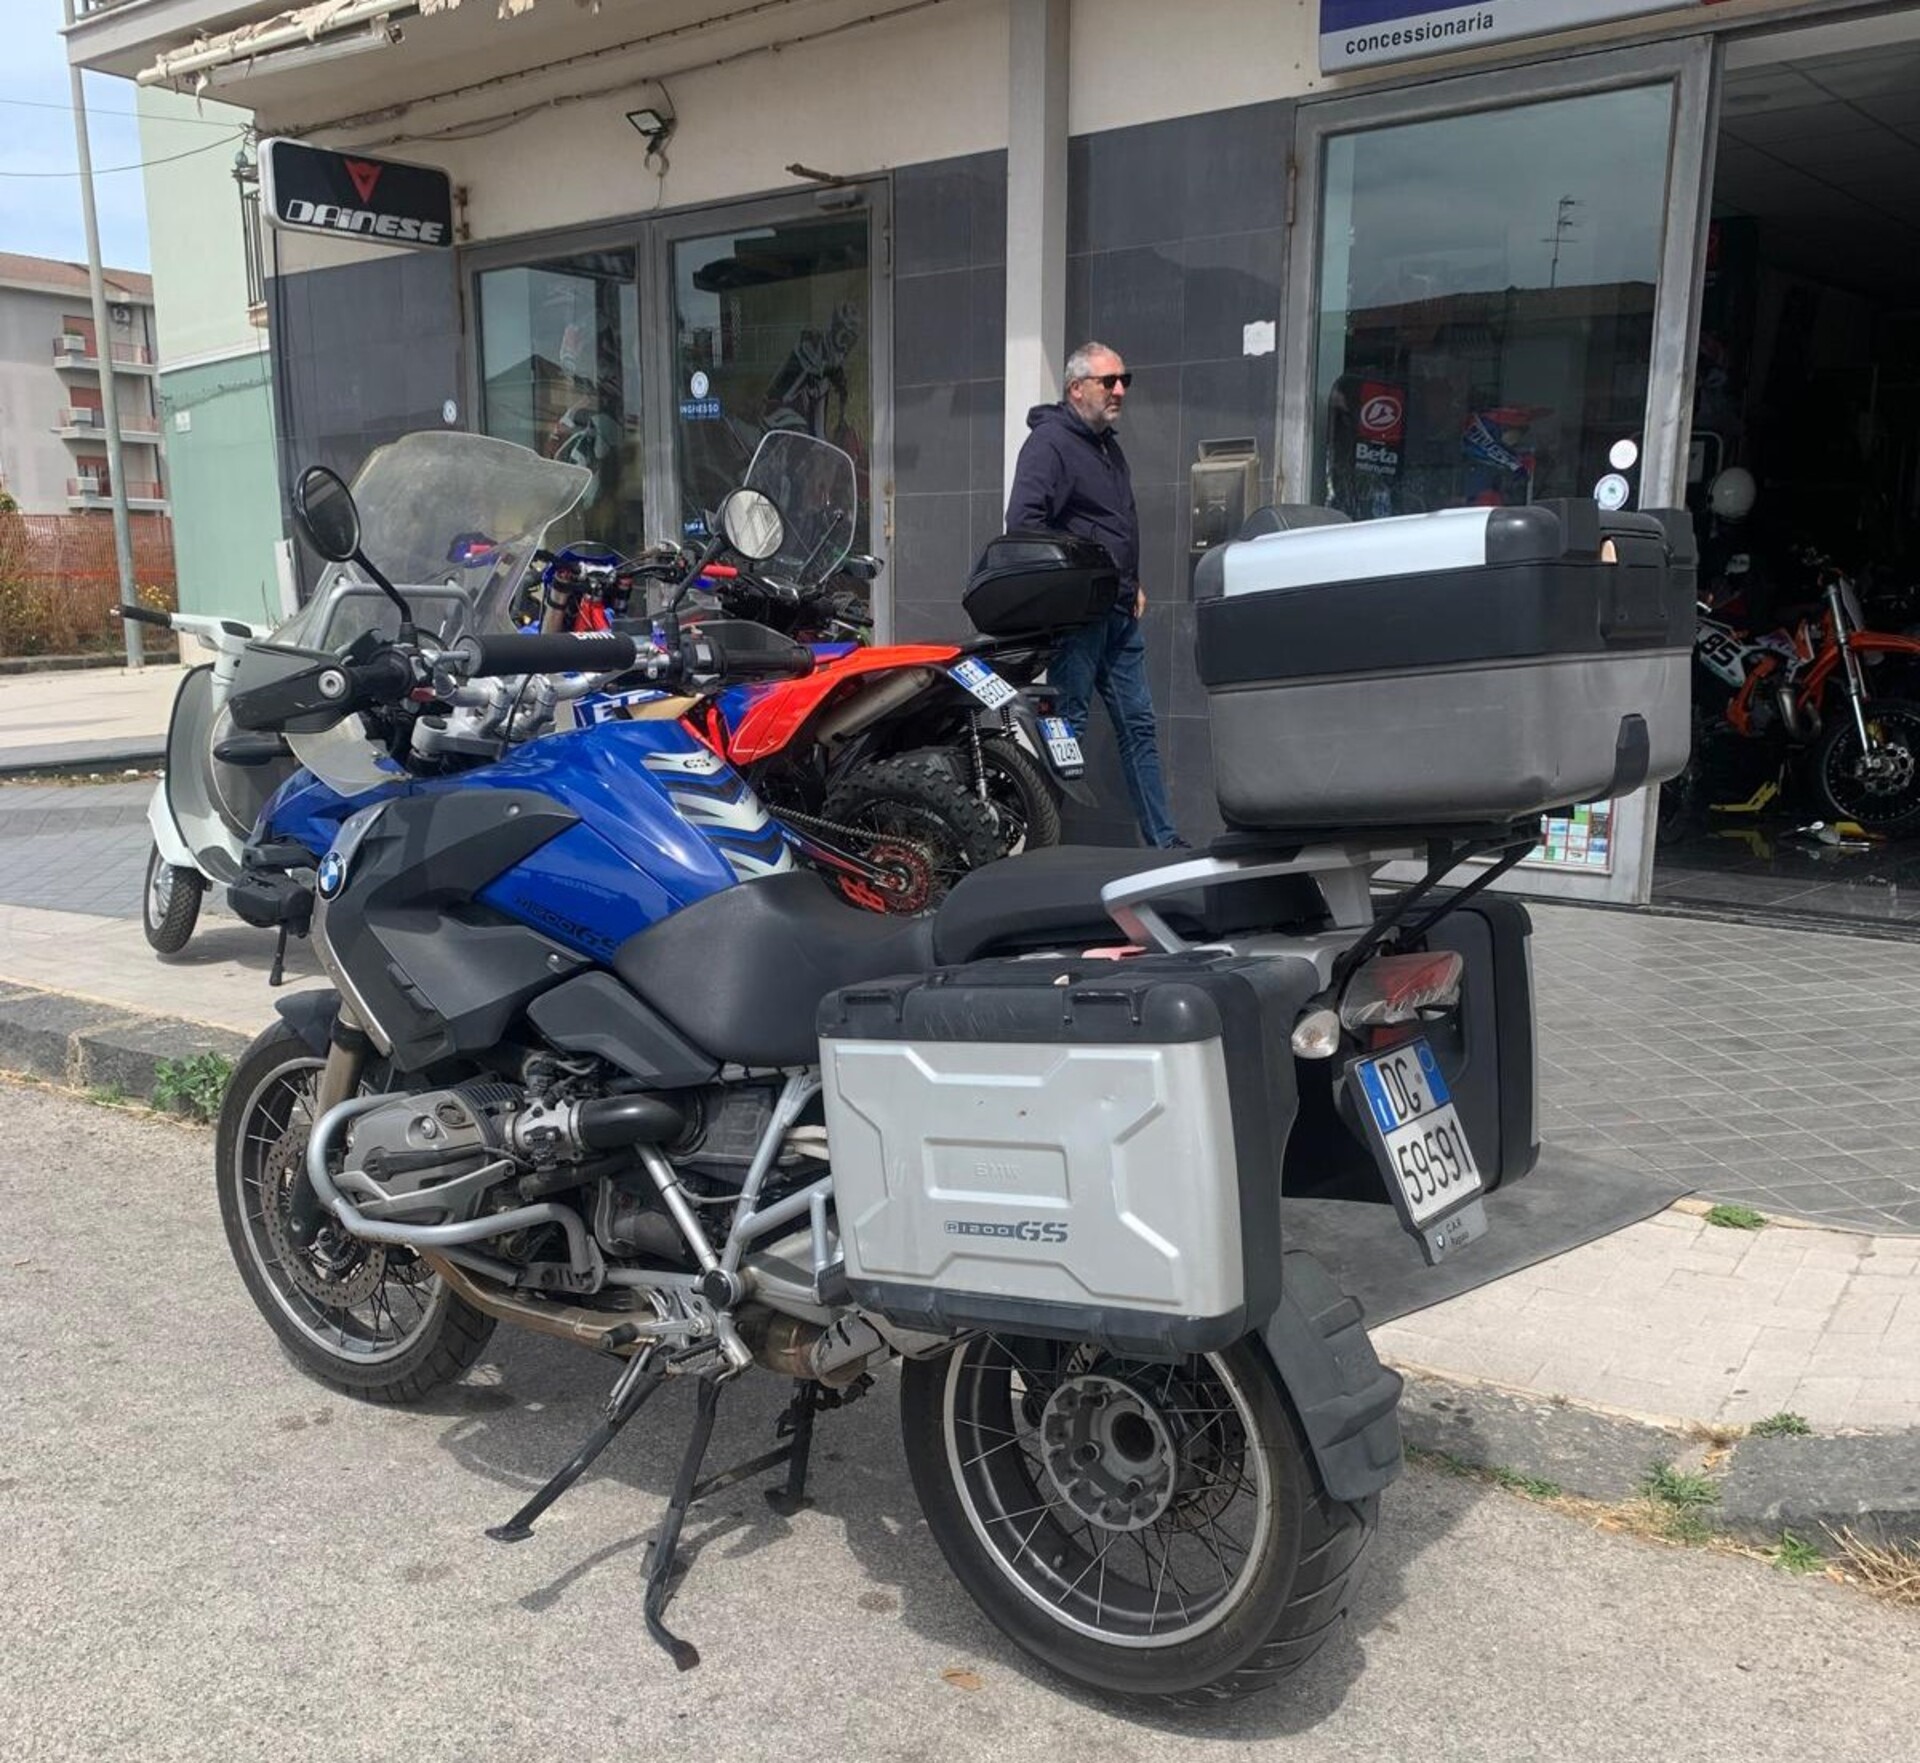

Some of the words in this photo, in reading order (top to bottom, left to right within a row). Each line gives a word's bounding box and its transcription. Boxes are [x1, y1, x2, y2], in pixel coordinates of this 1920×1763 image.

[1346, 12, 1494, 54] concessionaria
[1356, 442, 1398, 464] Beta
[1701, 632, 1742, 667] 85
[1379, 1058, 1422, 1121] DG
[1397, 1119, 1473, 1205] 59591
